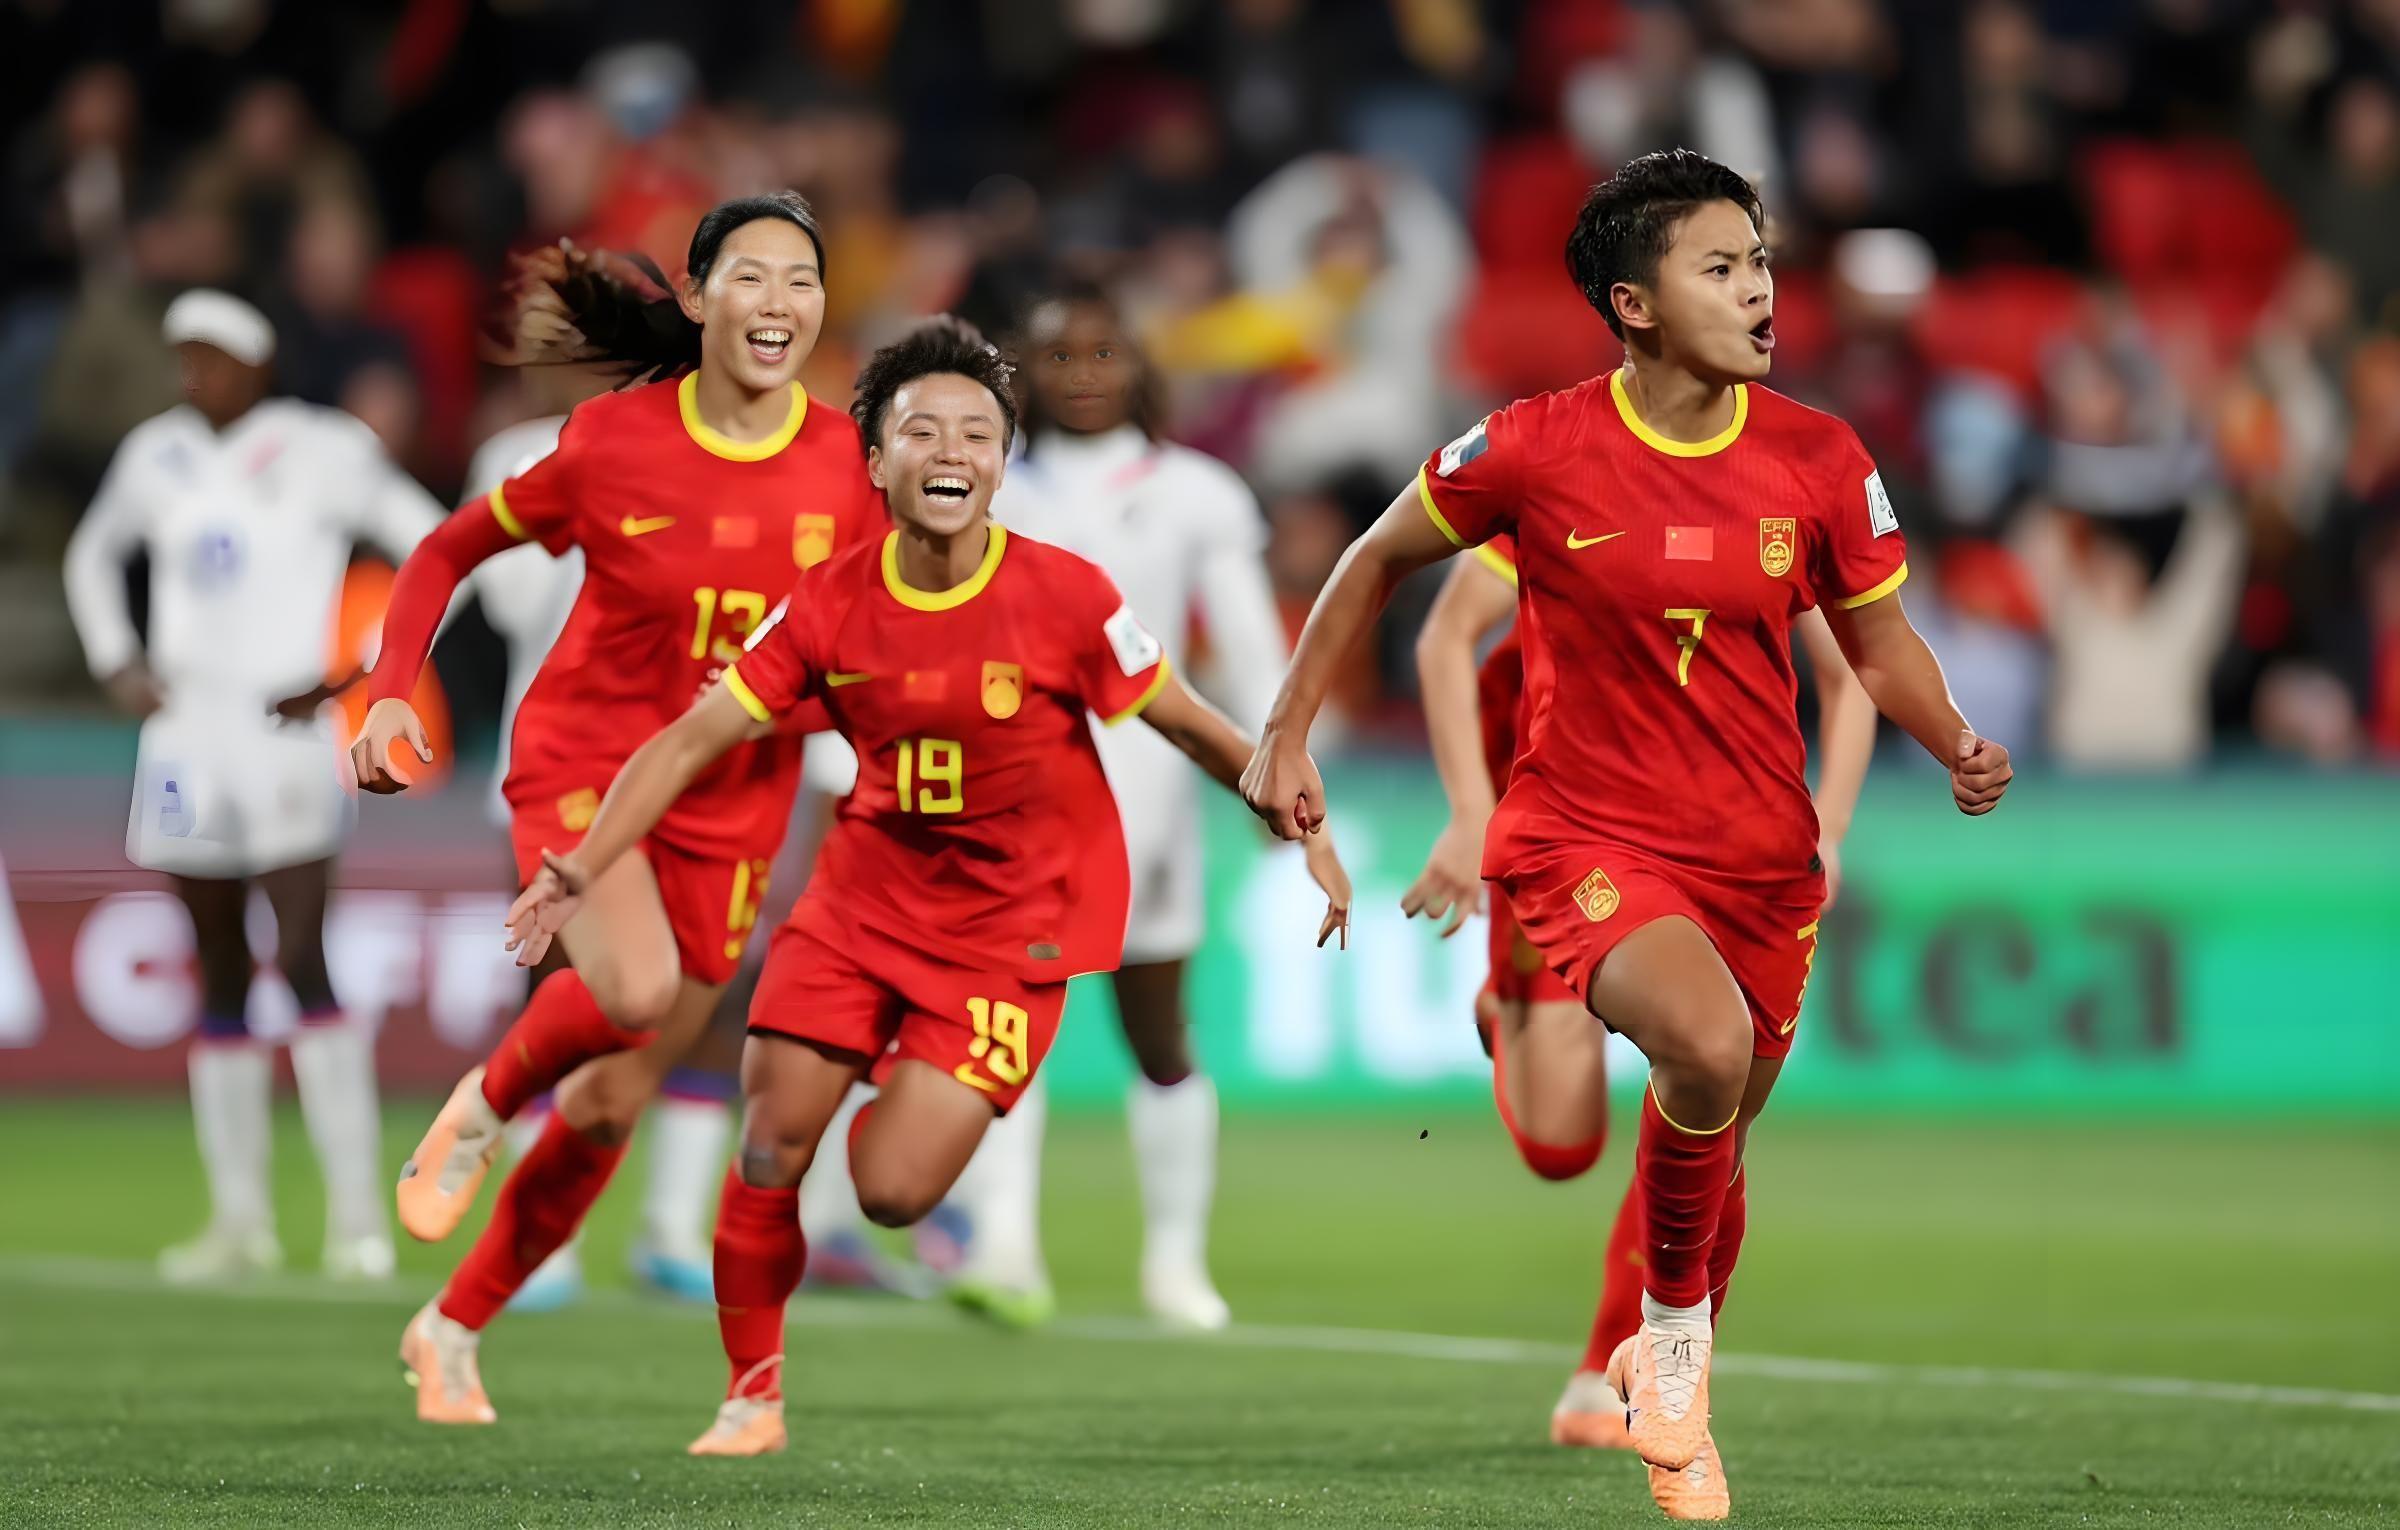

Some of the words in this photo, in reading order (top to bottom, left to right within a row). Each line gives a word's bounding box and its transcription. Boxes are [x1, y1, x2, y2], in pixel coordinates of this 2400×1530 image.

[690, 586, 767, 663] 13
[1664, 608, 1712, 687] 7
[896, 738, 964, 814] 19
[966, 997, 1028, 1085] 19
